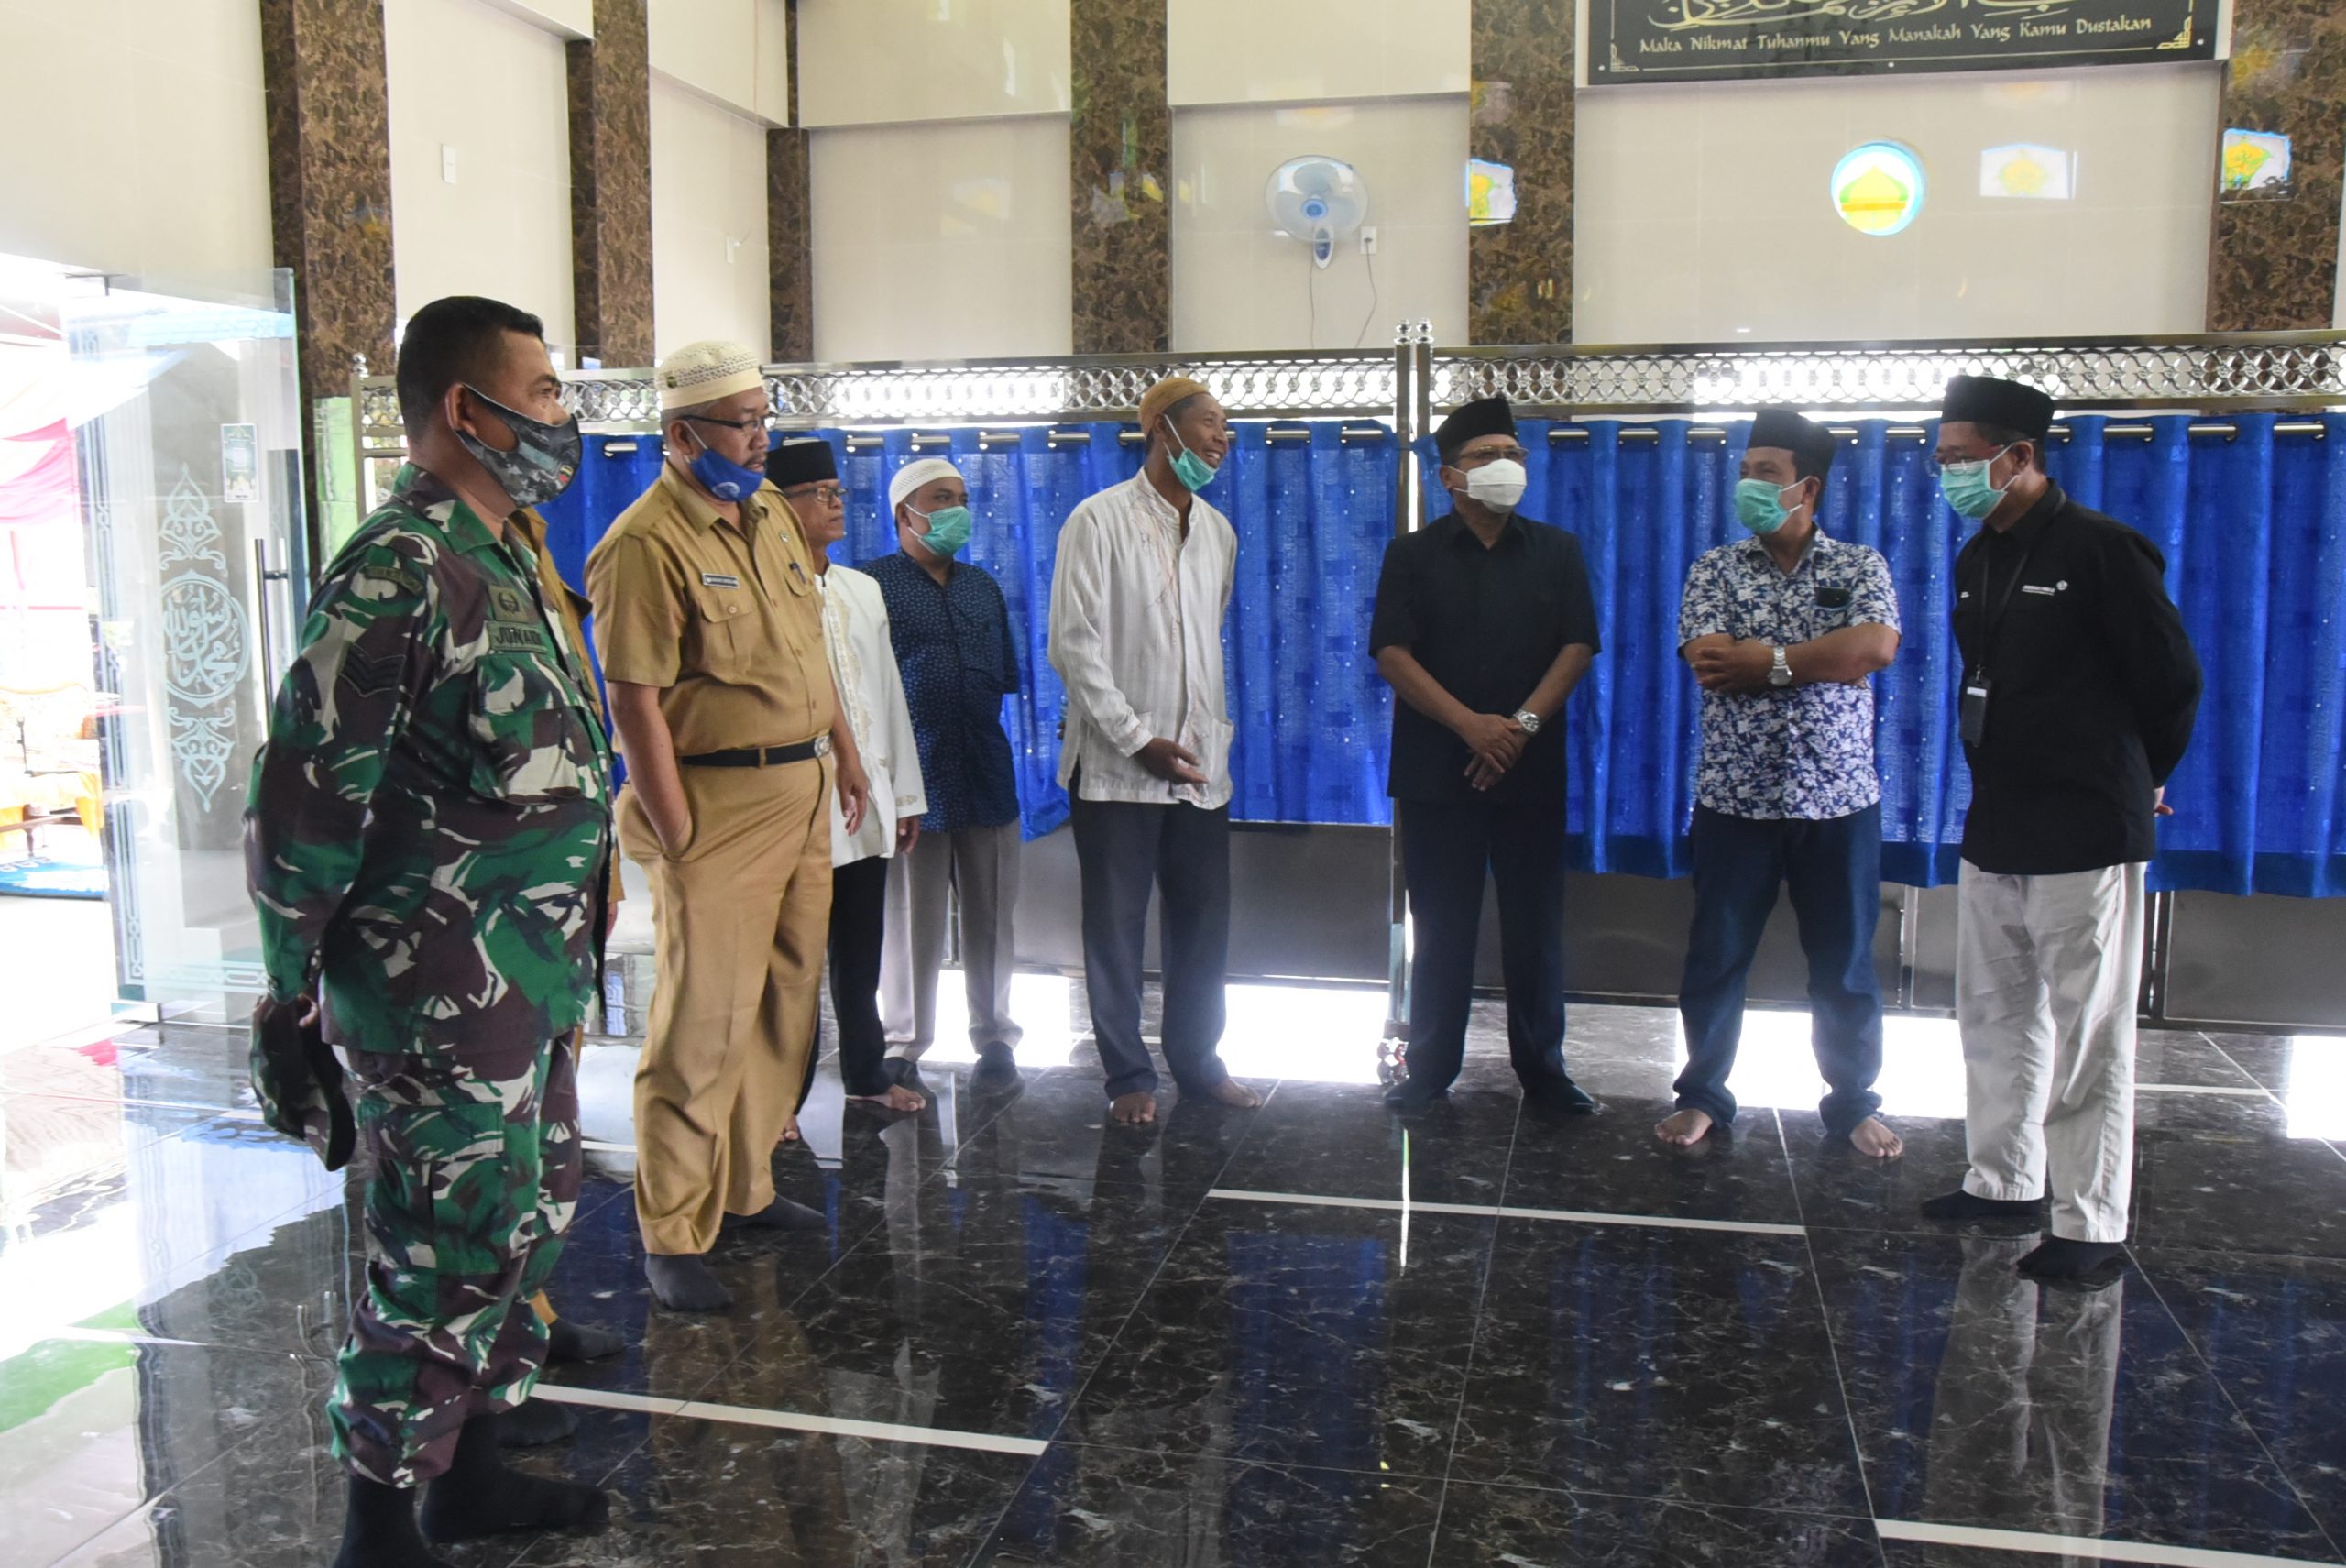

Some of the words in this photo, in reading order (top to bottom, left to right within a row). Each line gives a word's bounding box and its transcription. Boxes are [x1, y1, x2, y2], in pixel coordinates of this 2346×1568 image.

[1639, 37, 1682, 53] Maka
[1690, 35, 1748, 51] Nikmat
[1758, 32, 1830, 50] Tuhanmu
[1839, 29, 1880, 49] Yang
[1888, 24, 1961, 43] Manakah
[1970, 23, 2011, 42] Yang
[2019, 20, 2067, 38] Kamu
[2076, 15, 2152, 35] Dustakan
